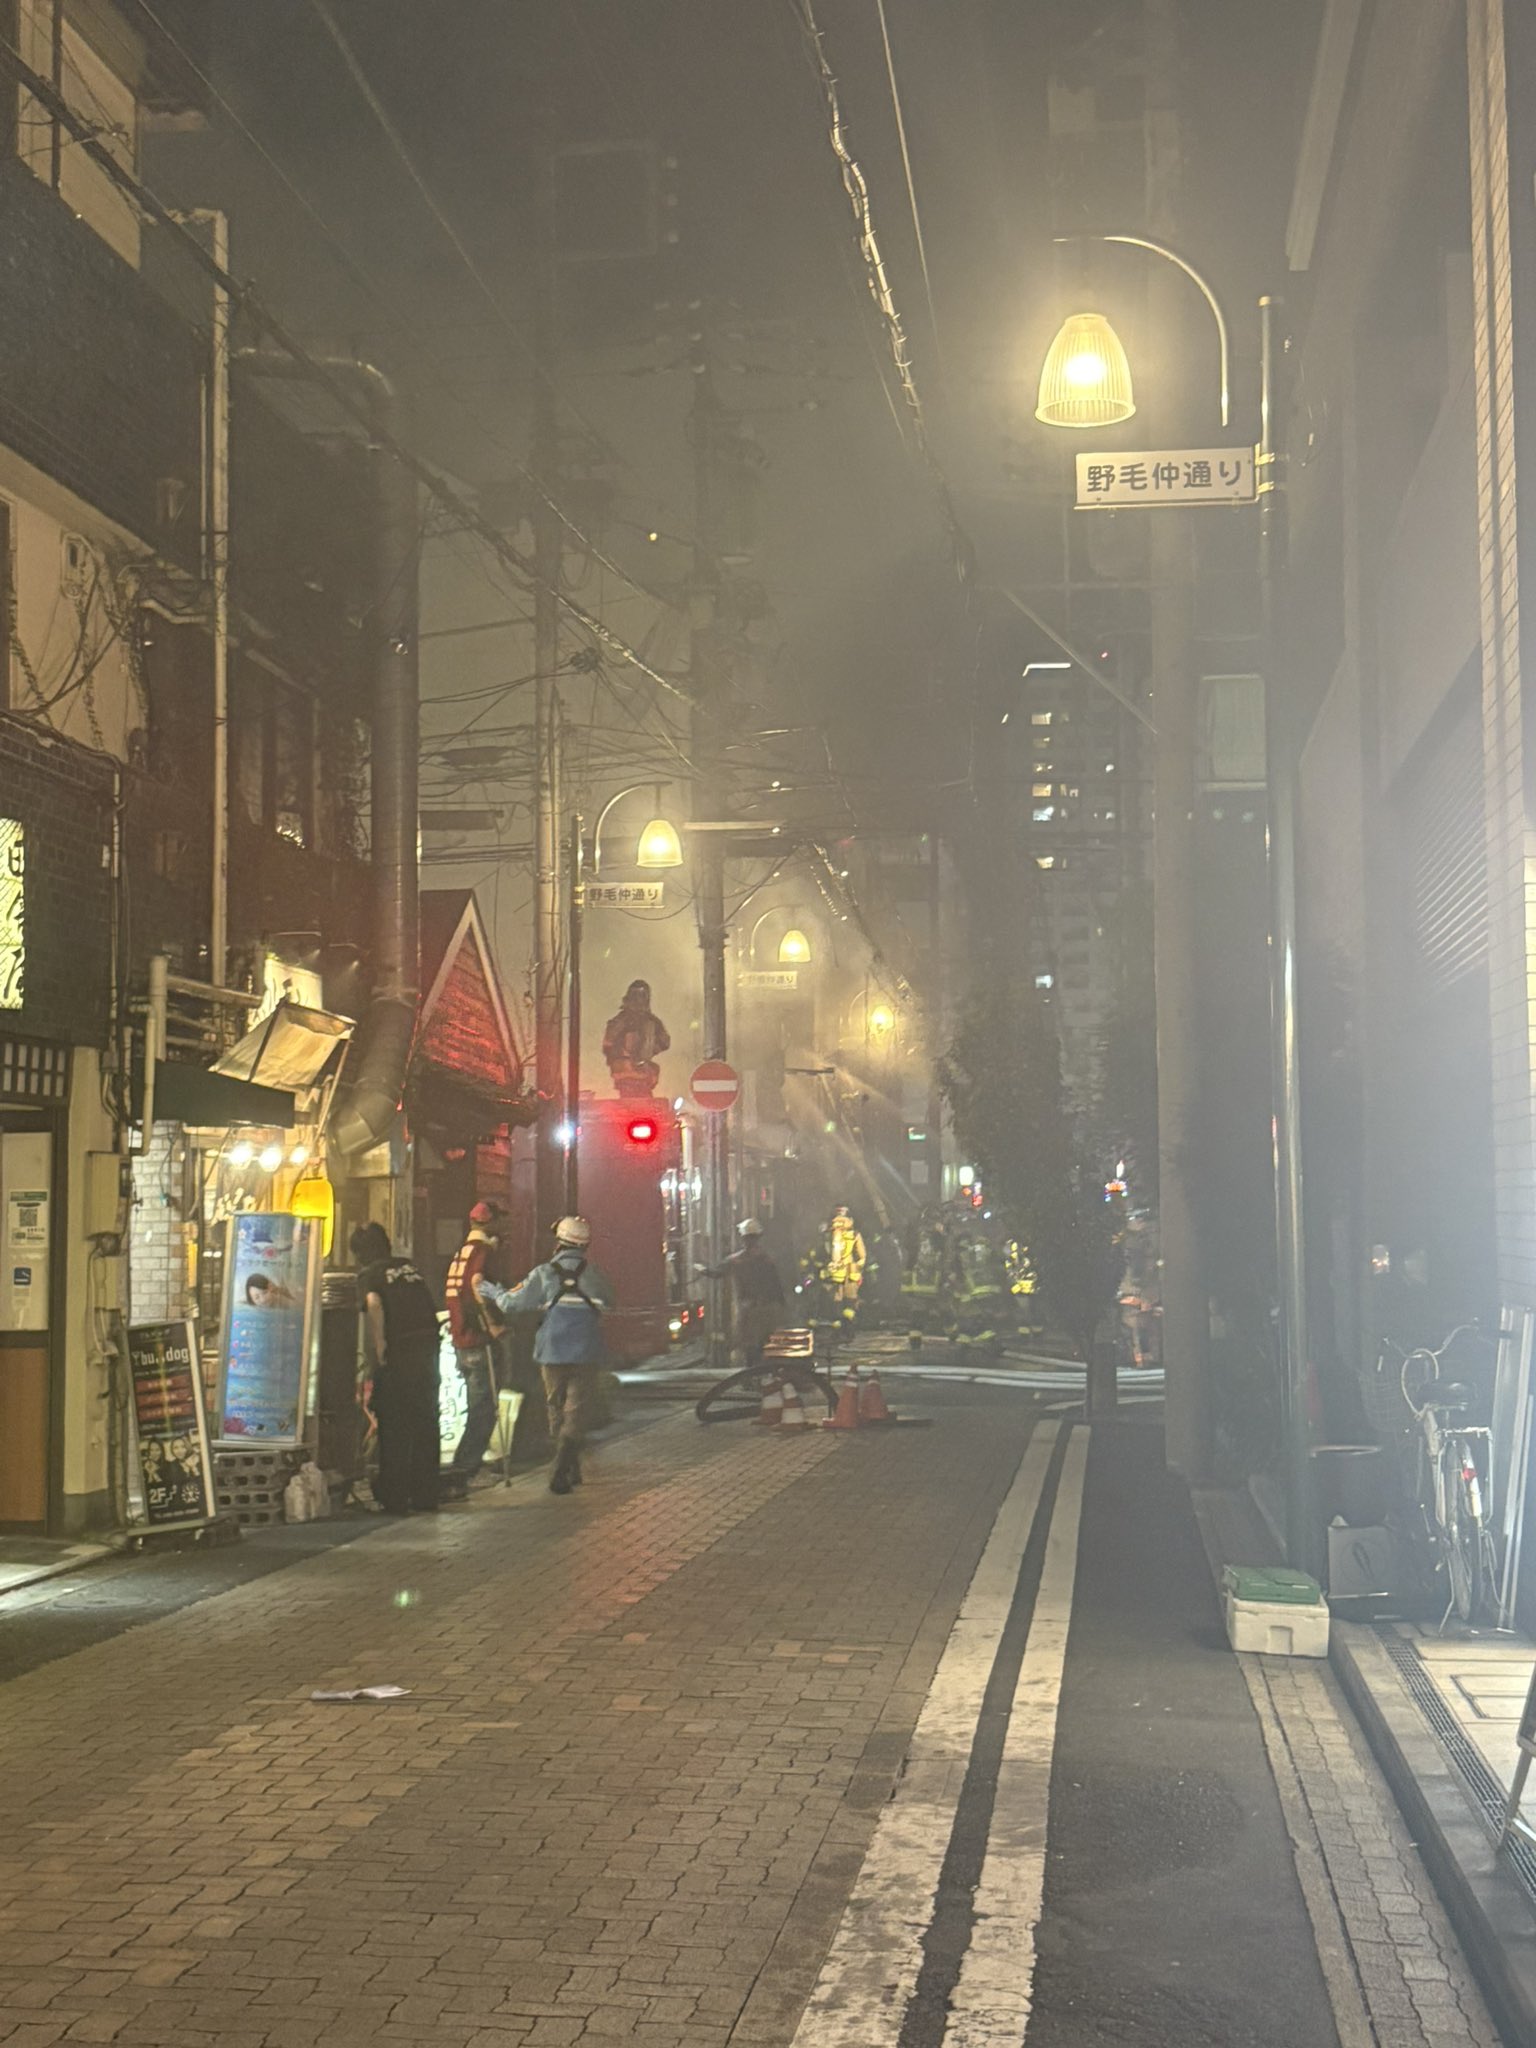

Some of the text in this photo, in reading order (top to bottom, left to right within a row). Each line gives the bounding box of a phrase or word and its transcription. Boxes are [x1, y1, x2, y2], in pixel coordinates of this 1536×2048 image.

[1086, 460, 1242, 493] 野毛仲通り
[588, 887, 659, 902] 野毛仲通り
[149, 1487, 167, 1504] 2F
